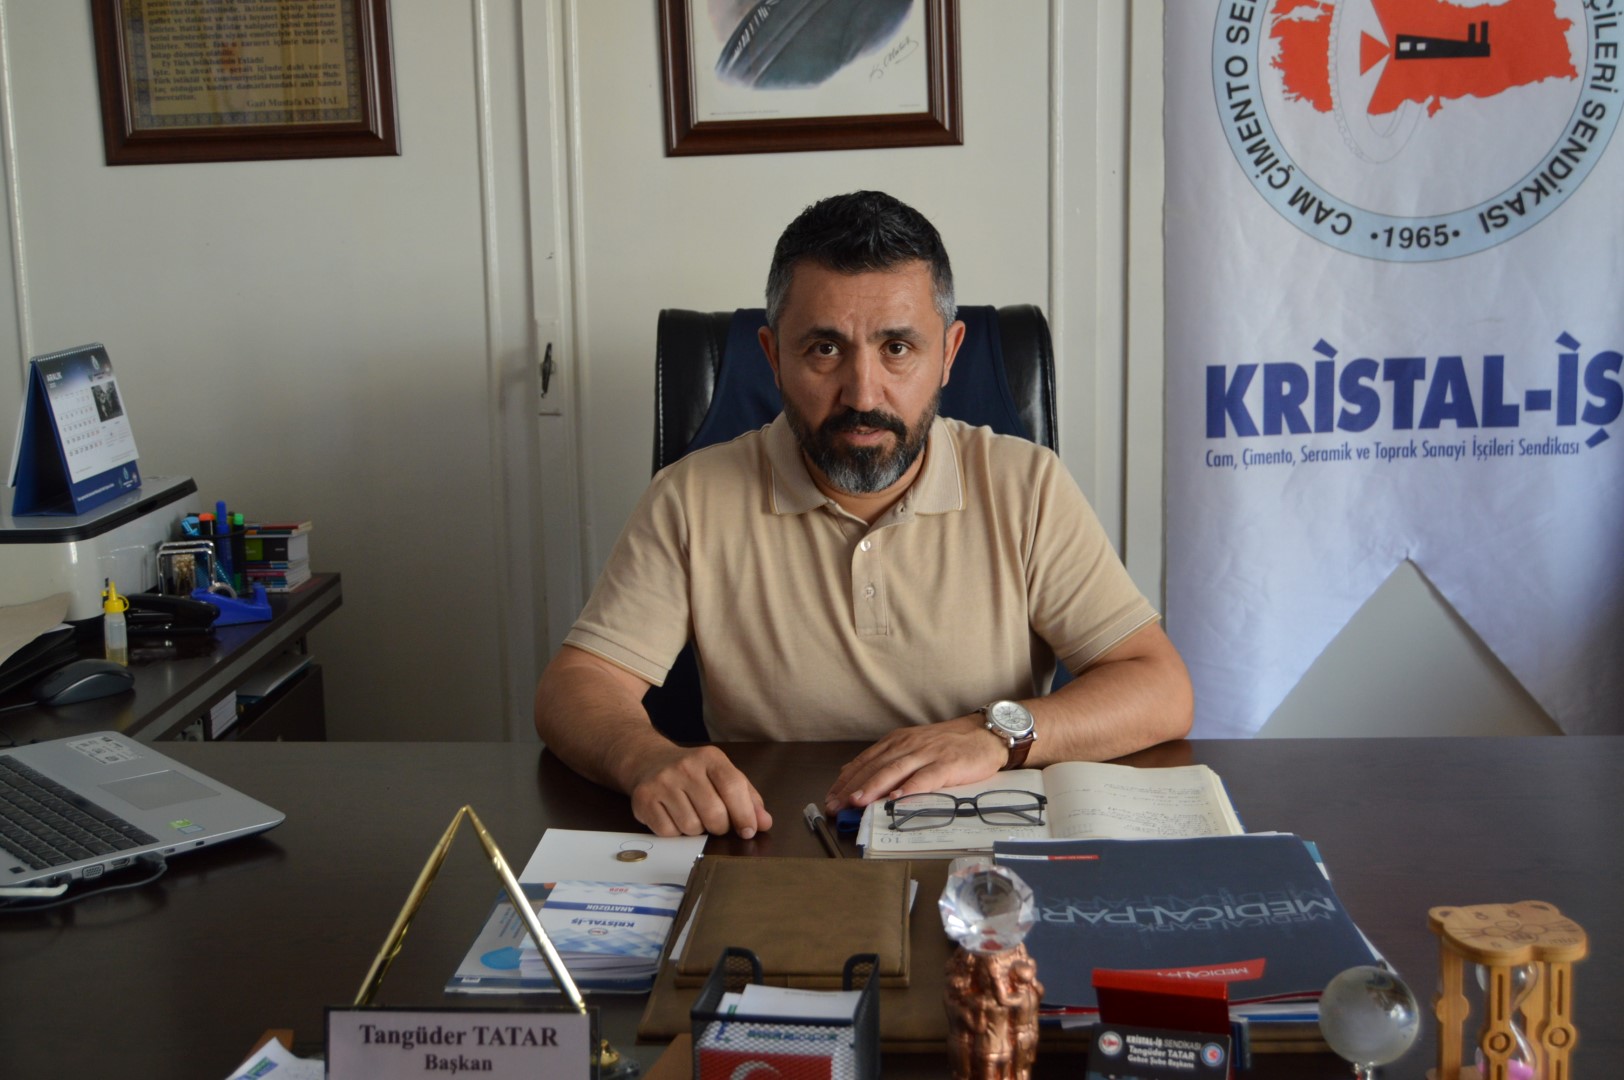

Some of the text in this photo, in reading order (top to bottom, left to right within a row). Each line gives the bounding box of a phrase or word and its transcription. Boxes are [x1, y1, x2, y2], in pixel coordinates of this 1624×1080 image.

[1224, 0, 1353, 236] CAM ÇİMENTO SE
[1479, 99, 1607, 235] SENDİKASI
[1206, 331, 1624, 449] KRİSTAL-İŞ
[1206, 434, 1580, 471] Cam, Çimento, Seramik ve Toprak Sanayi İşçileri Sendikası
[359, 1024, 559, 1050] Tangüder TATAR
[1129, 1045, 1195, 1060] Tangüder TATAR
[425, 1054, 493, 1074] Başkan
